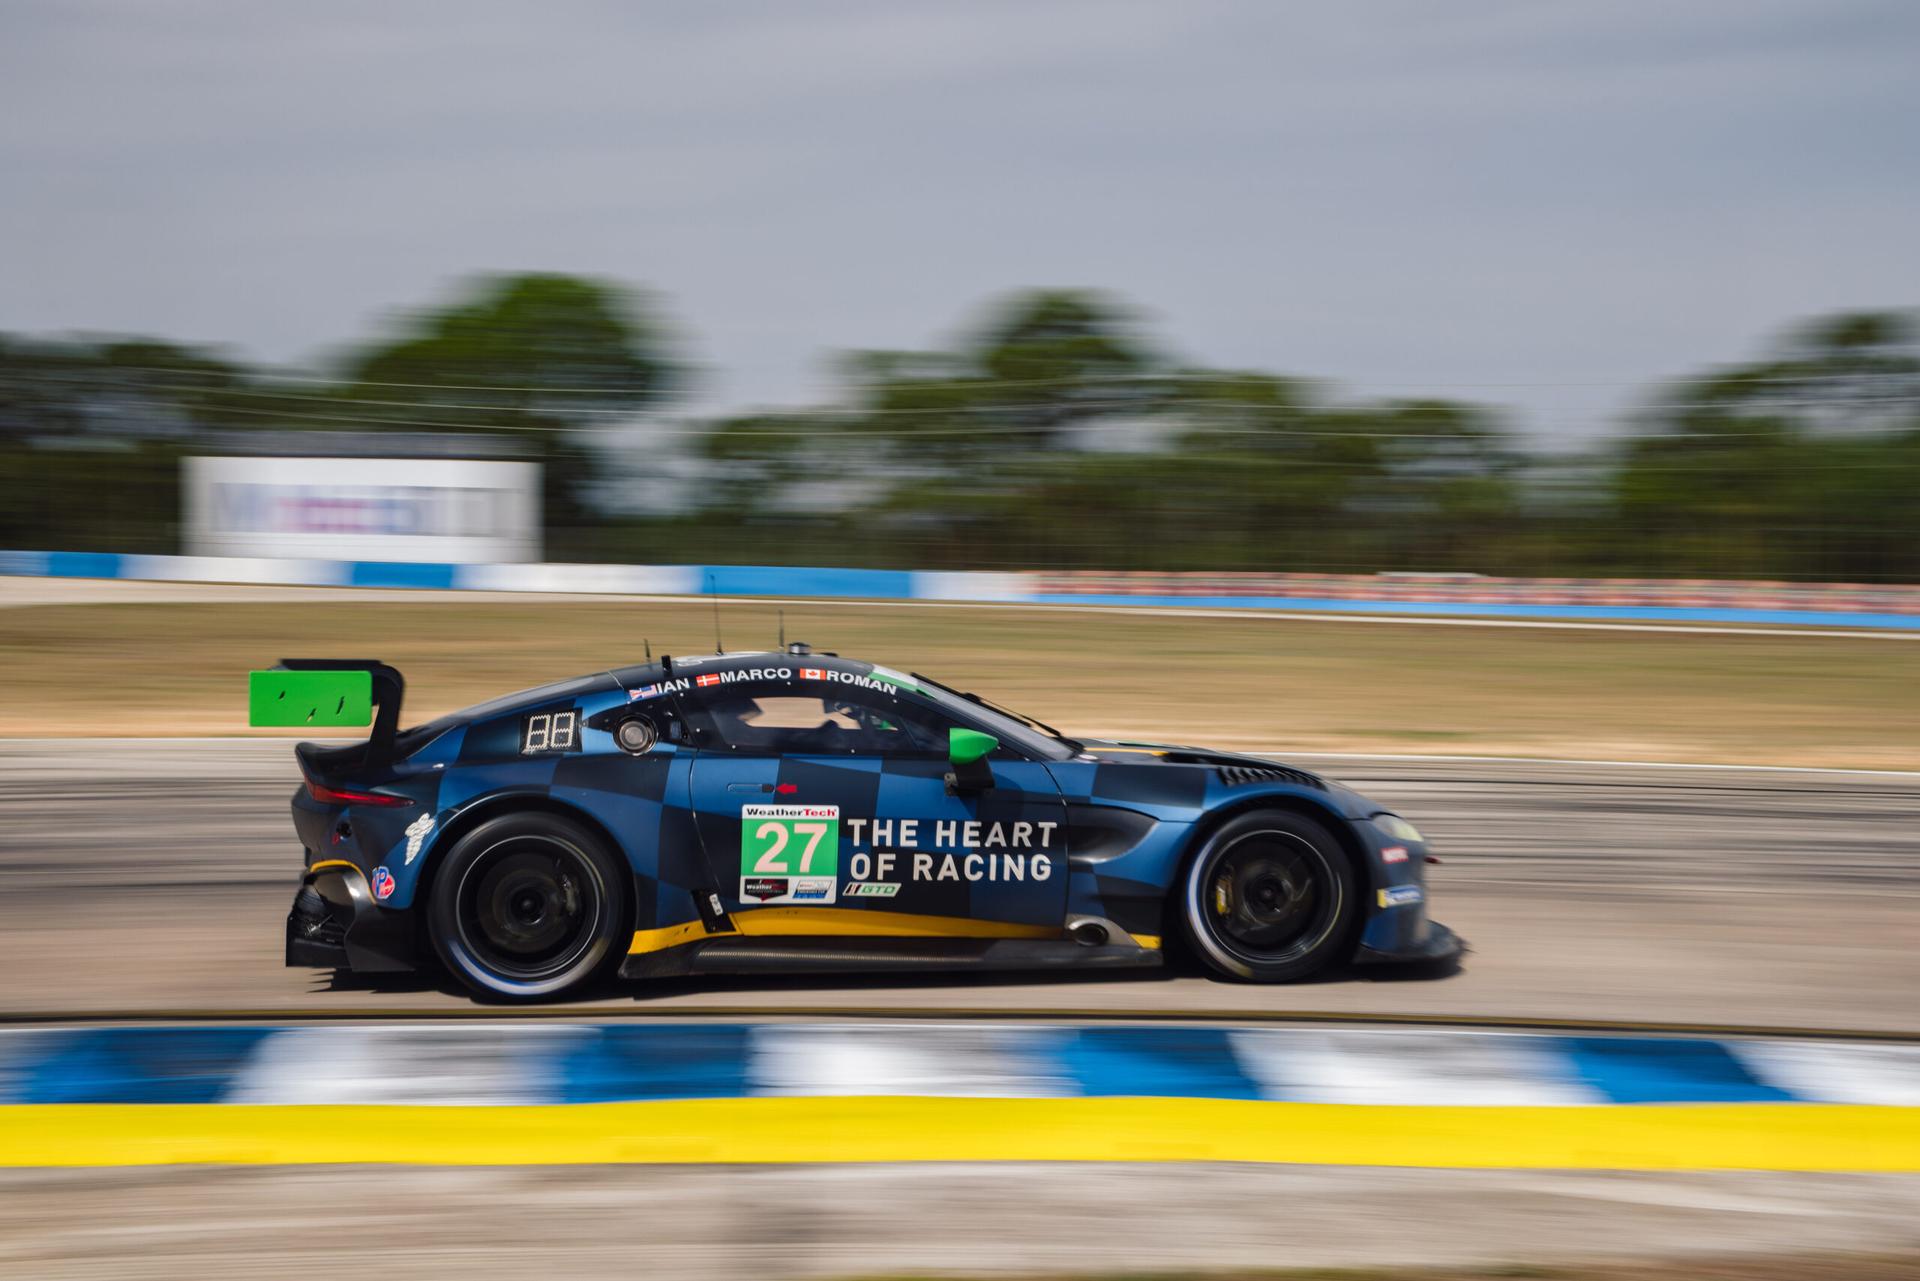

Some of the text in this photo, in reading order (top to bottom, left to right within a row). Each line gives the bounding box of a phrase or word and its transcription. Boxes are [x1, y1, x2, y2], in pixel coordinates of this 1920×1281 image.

[720, 667, 792, 684] MARCO
[826, 670, 897, 695] ROMAN
[655, 678, 690, 695] IAN
[746, 808, 837, 817] WeatherTech
[847, 818, 1058, 848] THE HEART
[753, 822, 828, 873] 27
[850, 853, 1052, 882] OF RACING
[861, 886, 896, 895] GTD
